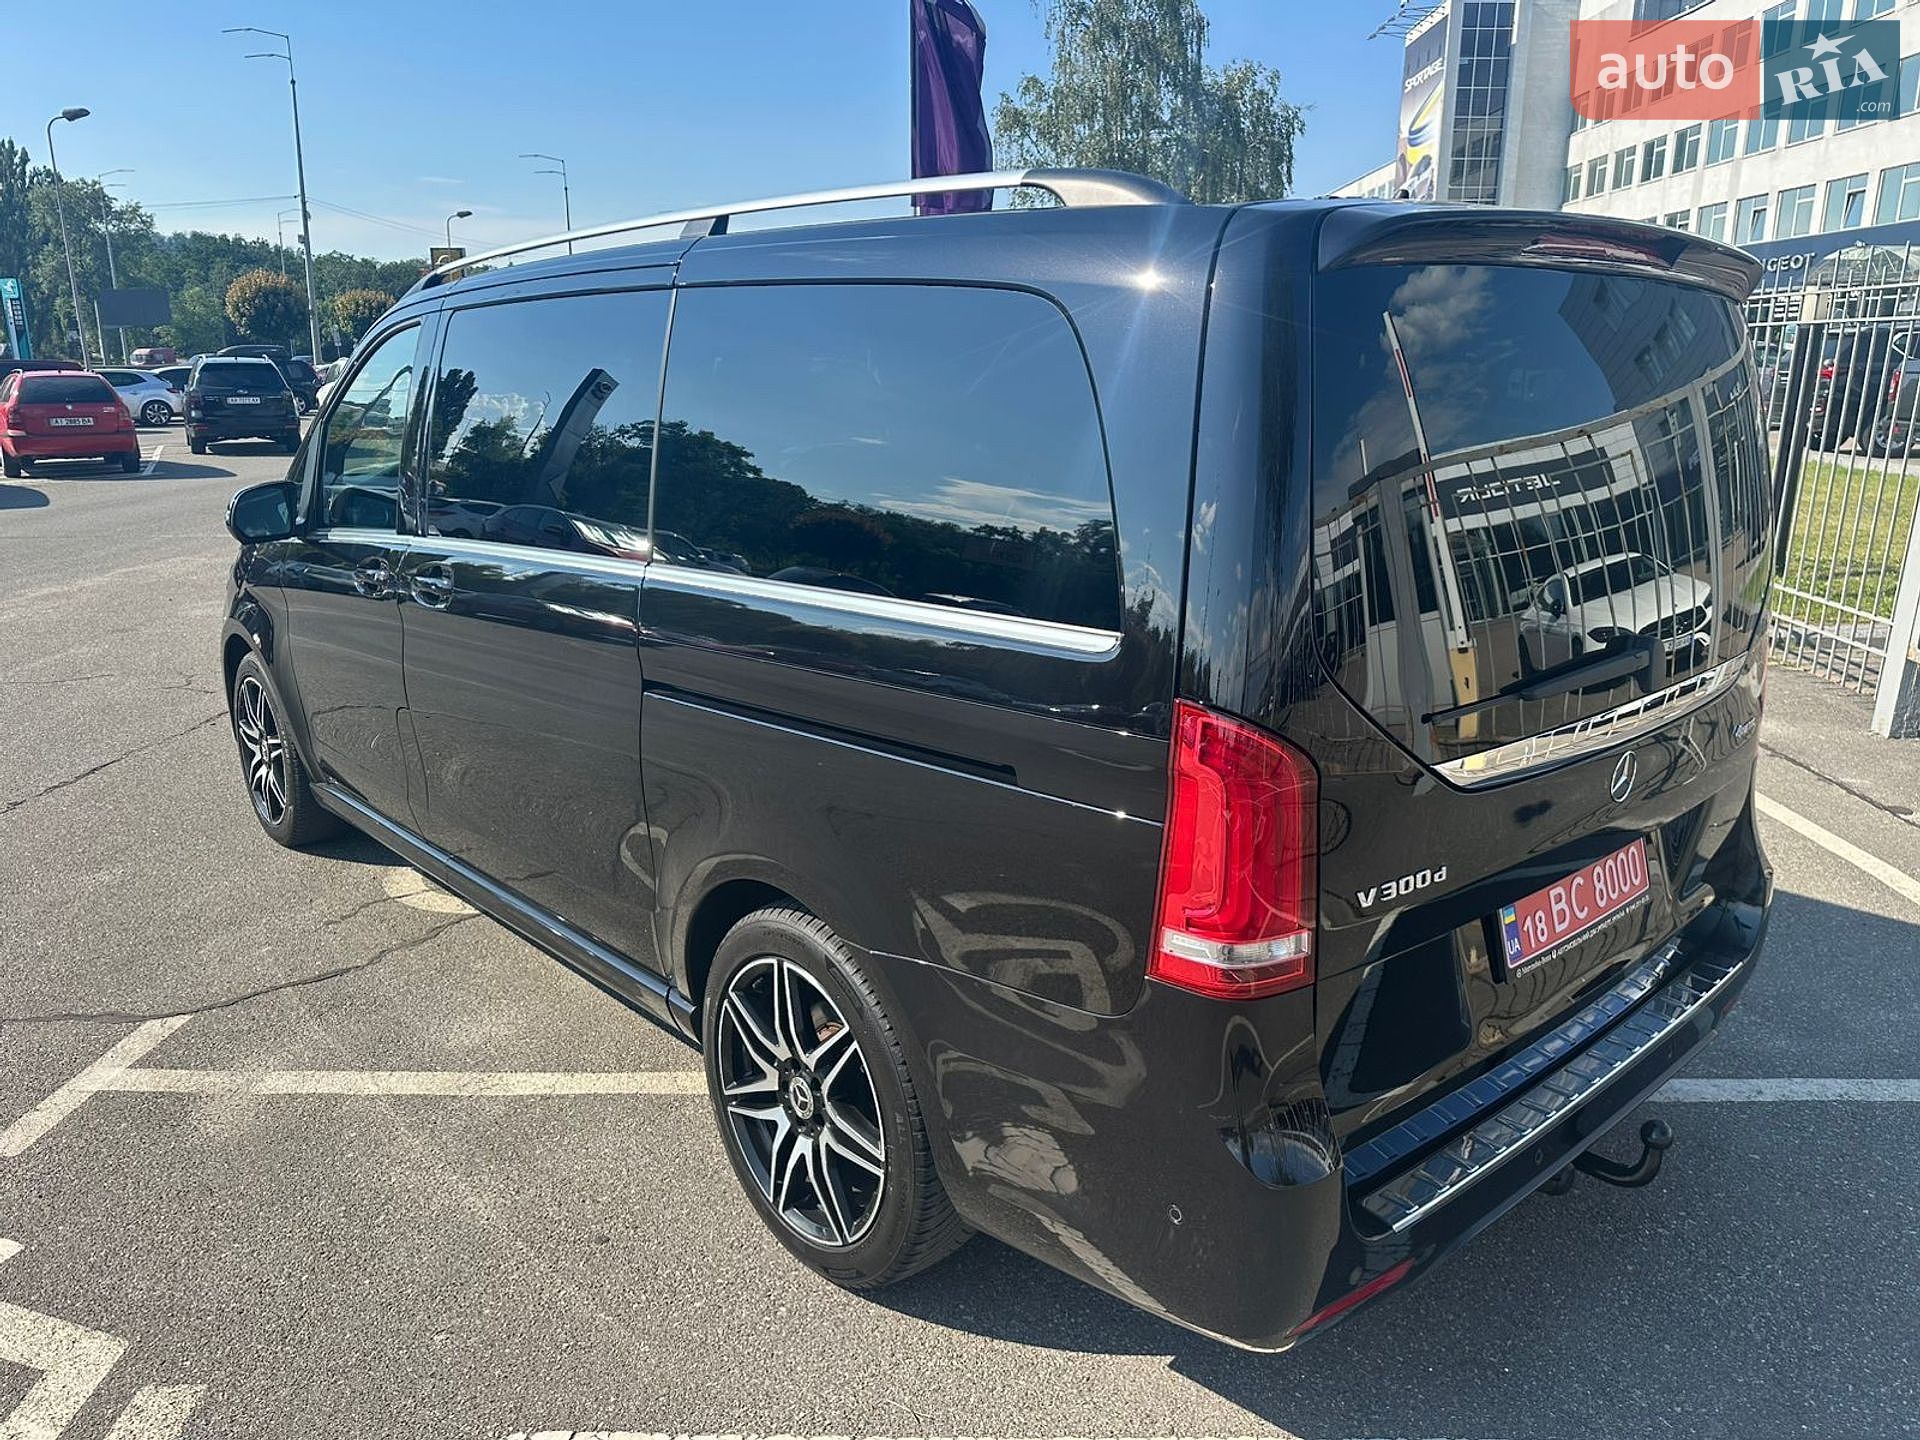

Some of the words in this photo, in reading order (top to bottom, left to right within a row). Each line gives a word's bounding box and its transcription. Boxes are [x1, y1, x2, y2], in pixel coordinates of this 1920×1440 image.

[1356, 887, 1378, 908] V
[1380, 866, 1447, 902] 300d
[1522, 909, 1548, 949] 18
[1549, 876, 1589, 933] BC
[1593, 846, 1641, 908] 8000
[1507, 937, 1521, 955] UA
